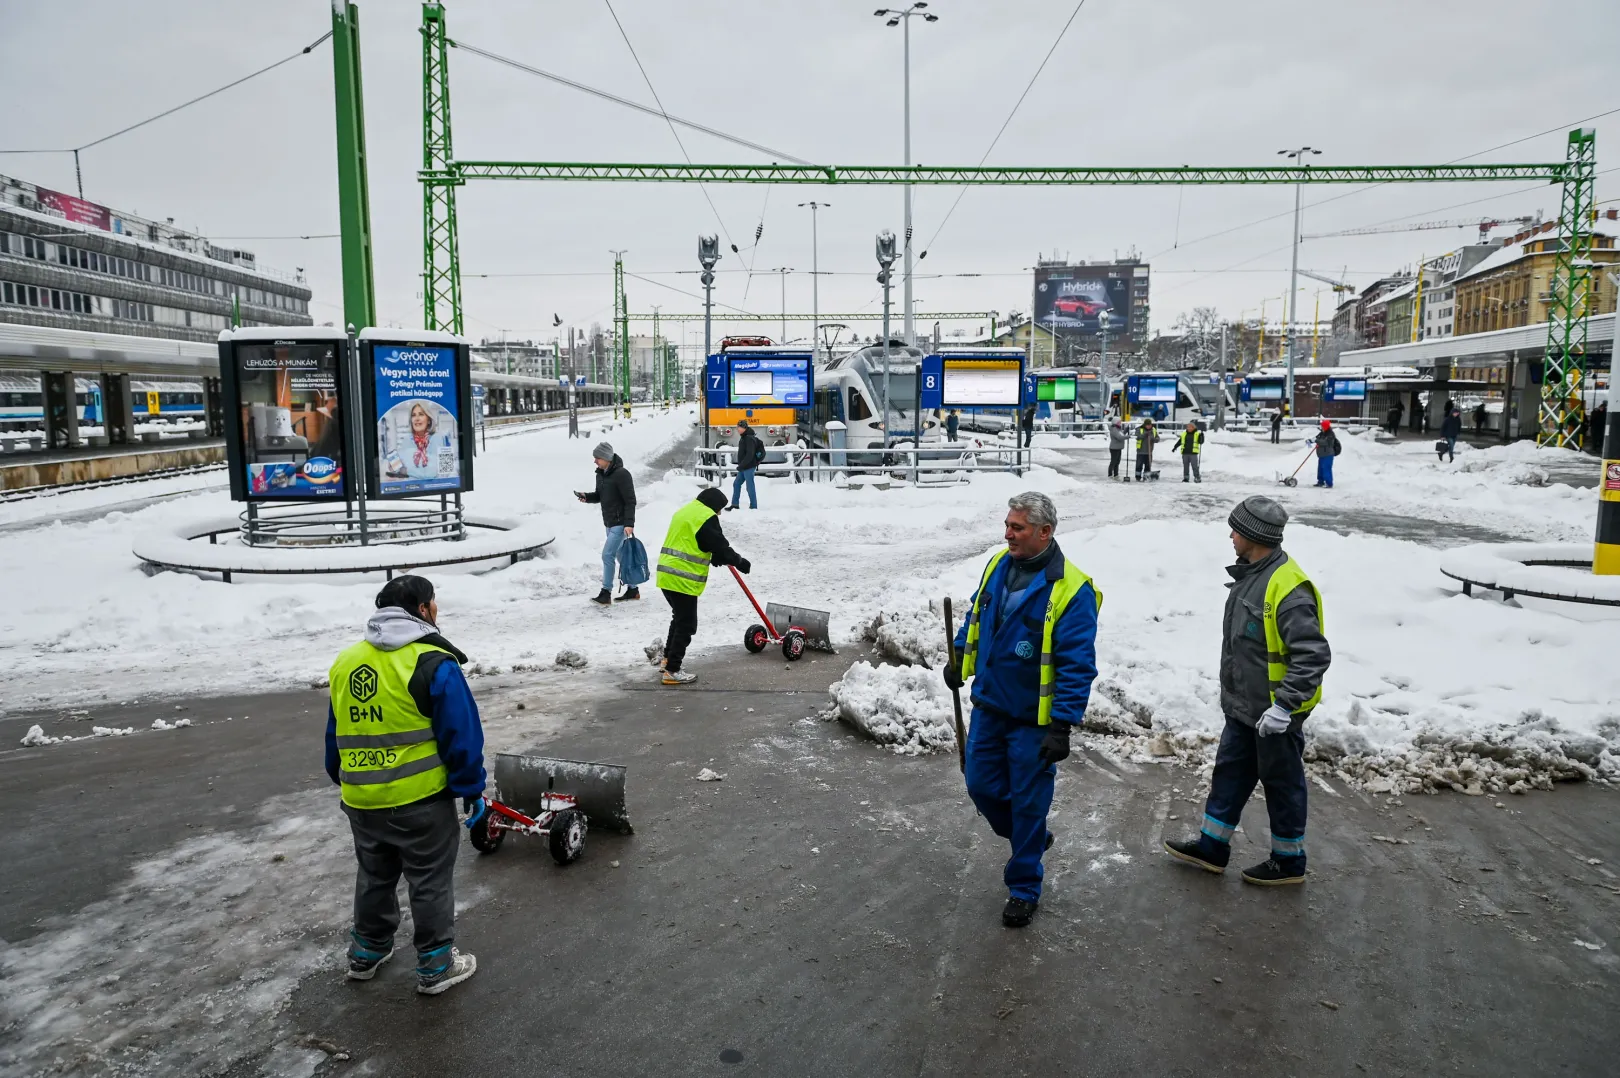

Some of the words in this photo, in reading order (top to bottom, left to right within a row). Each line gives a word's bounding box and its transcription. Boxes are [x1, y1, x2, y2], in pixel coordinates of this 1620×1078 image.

[1063, 281, 1101, 292] Hybrid+
[246, 358, 277, 366] LEHÚZÓS
[285, 358, 318, 366] MUNKÁM
[380, 367, 408, 378] Vegye
[408, 368, 427, 378] jobb
[429, 369, 450, 377] áron!
[390, 380, 415, 388] Gyöngy
[415, 380, 443, 388] Prémium
[711, 375, 721, 388] 7
[925, 375, 935, 388] 8
[390, 390, 413, 398] patikai
[1028, 385, 1033, 393] 9
[303, 461, 336, 474] Ooops!
[349, 704, 384, 723] B+N
[348, 749, 397, 768] 32905
